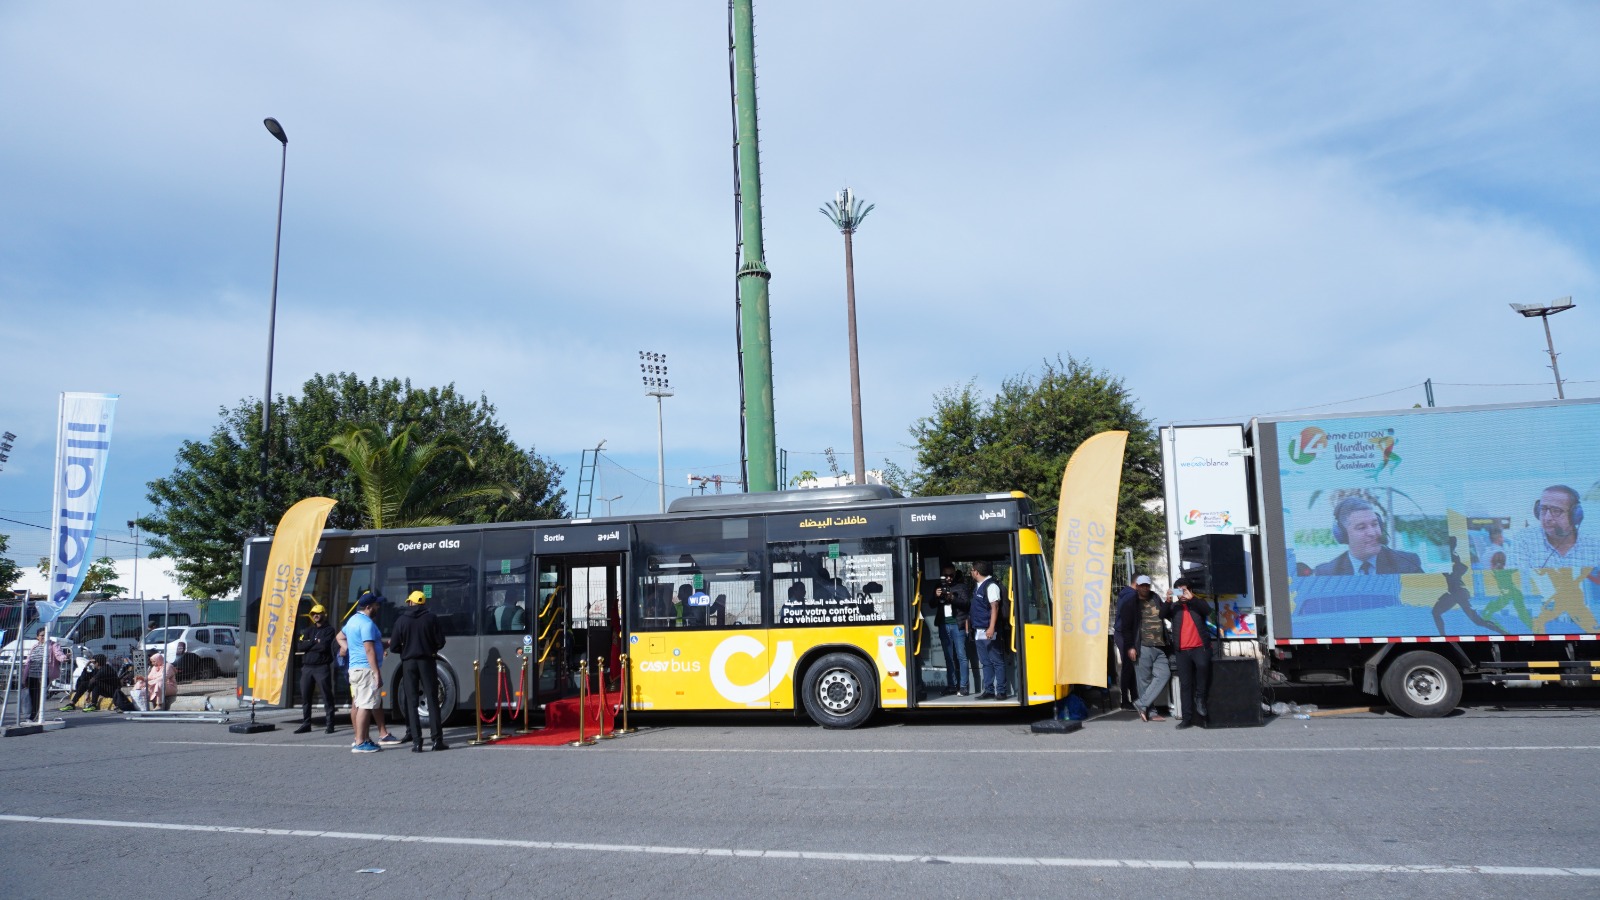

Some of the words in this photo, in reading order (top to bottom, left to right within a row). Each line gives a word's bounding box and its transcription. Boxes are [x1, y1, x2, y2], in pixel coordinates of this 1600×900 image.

[1348, 430, 1384, 440] EDITION
[910, 512, 937, 522] Entrée
[979, 508, 1006, 520] الدخول
[799, 517, 833, 529] البيضاء
[833, 515, 868, 526] حافلات
[543, 533, 565, 542] Sortie
[597, 530, 620, 542] الخروج
[397, 541, 422, 553] Opéré
[422, 541, 437, 551] par
[438, 539, 461, 549] alsa
[783, 608, 804, 617] Pour
[805, 607, 827, 616] votre
[828, 606, 860, 616] confort
[783, 616, 793, 624] ce
[795, 614, 831, 624] véhicule
[832, 614, 847, 622] est
[848, 612, 887, 622] climatisé
